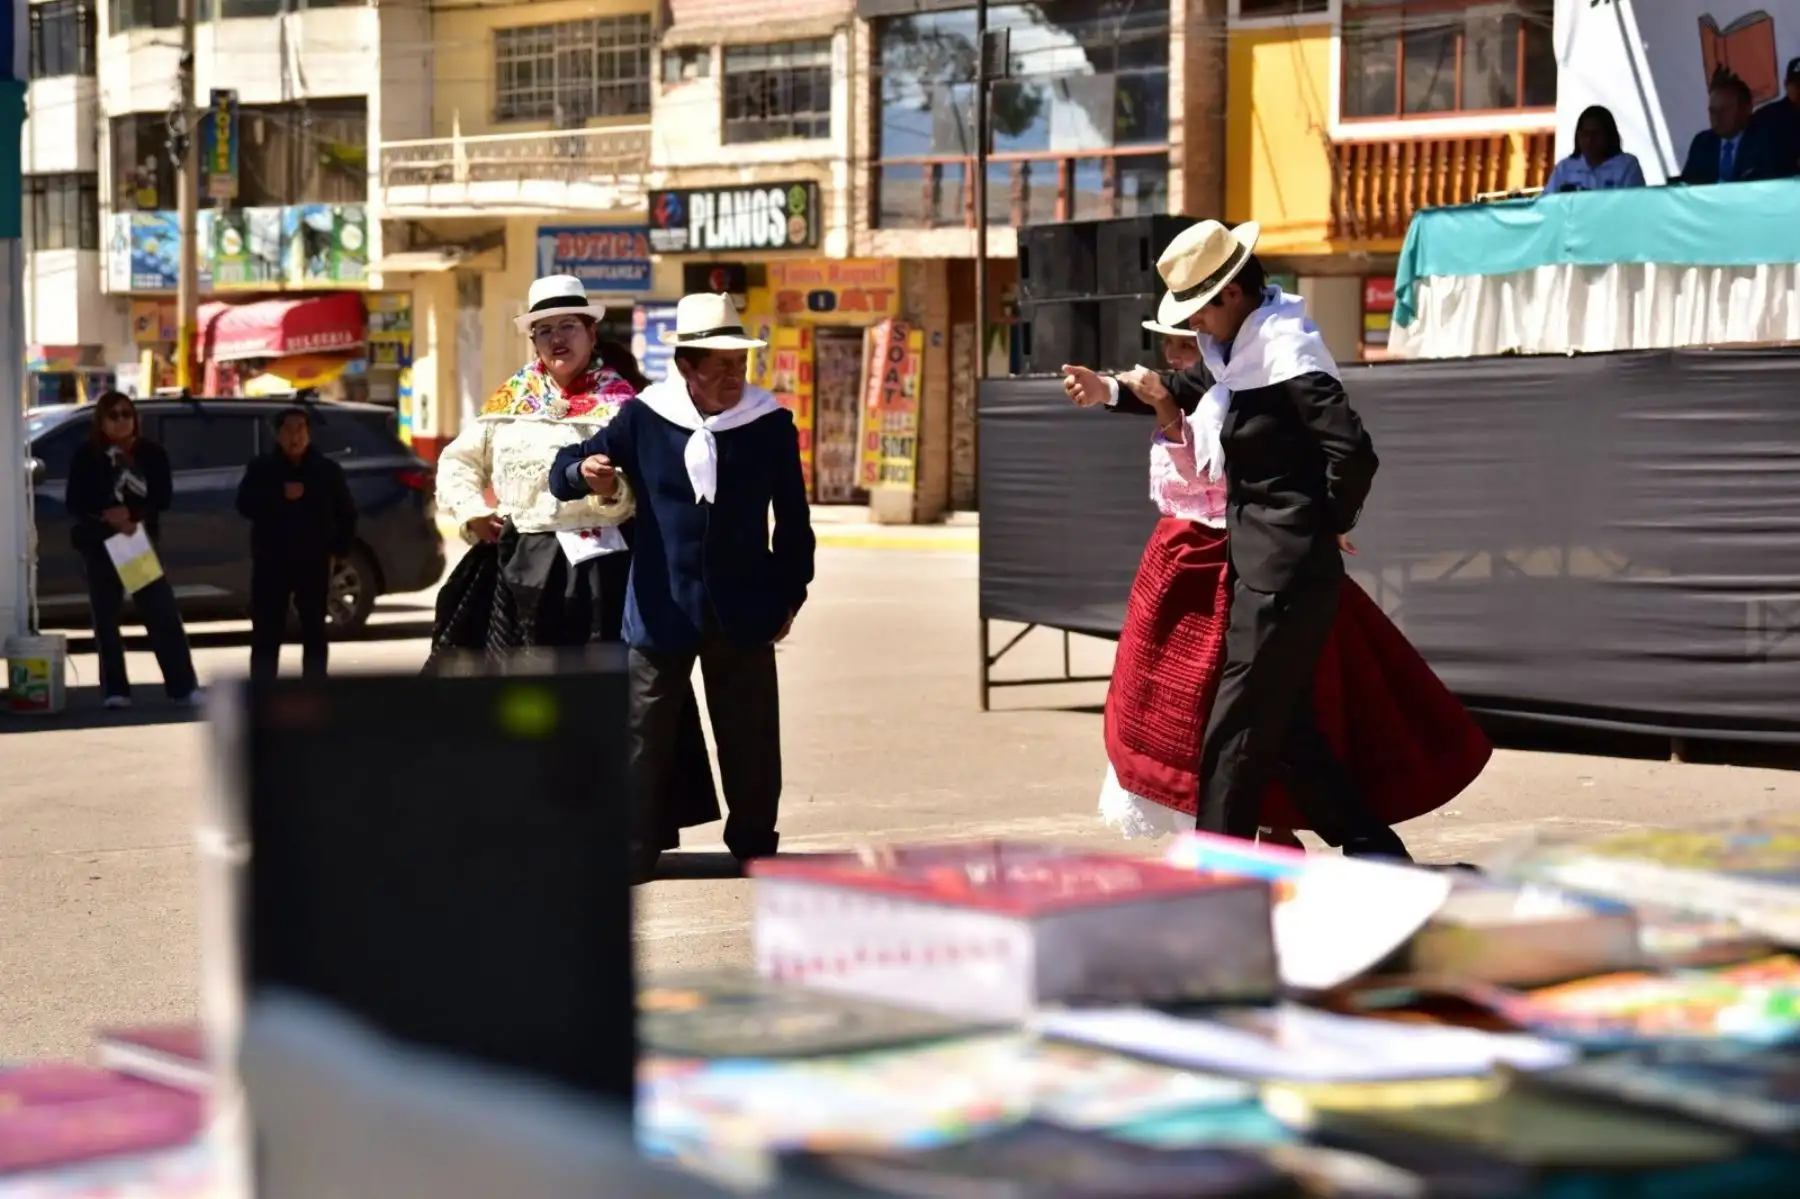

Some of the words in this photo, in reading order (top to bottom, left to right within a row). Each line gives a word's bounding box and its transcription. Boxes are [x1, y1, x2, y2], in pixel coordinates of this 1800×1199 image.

[688, 187, 788, 249] PLANOS
[555, 231, 649, 260] BOTICA
[775, 286, 897, 314] SOAT
